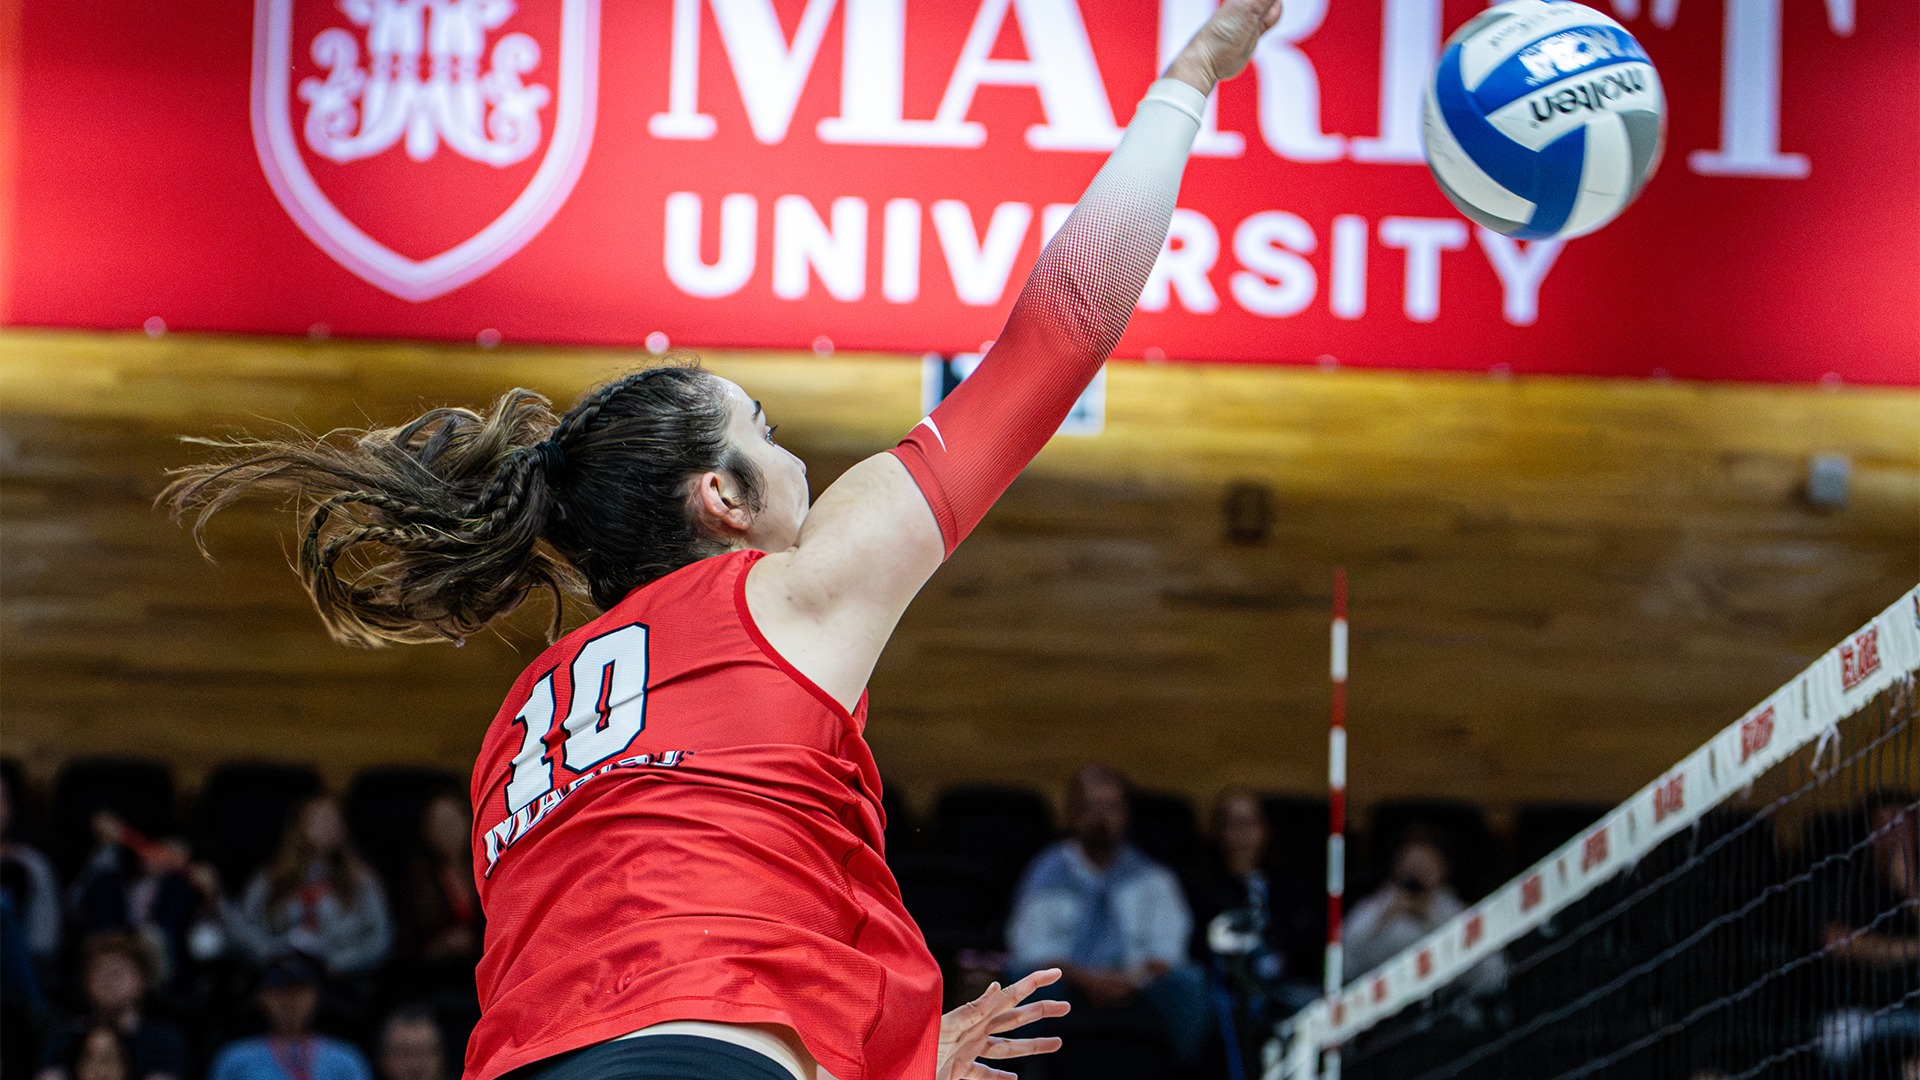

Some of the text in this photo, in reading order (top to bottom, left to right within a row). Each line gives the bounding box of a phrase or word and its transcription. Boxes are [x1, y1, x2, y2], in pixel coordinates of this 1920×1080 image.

[647, 0, 1856, 178] MARIT
[1528, 66, 1644, 122] molten
[664, 191, 1567, 325] UNIVRSITY
[504, 622, 650, 816] 10
[482, 750, 687, 879] MARS
